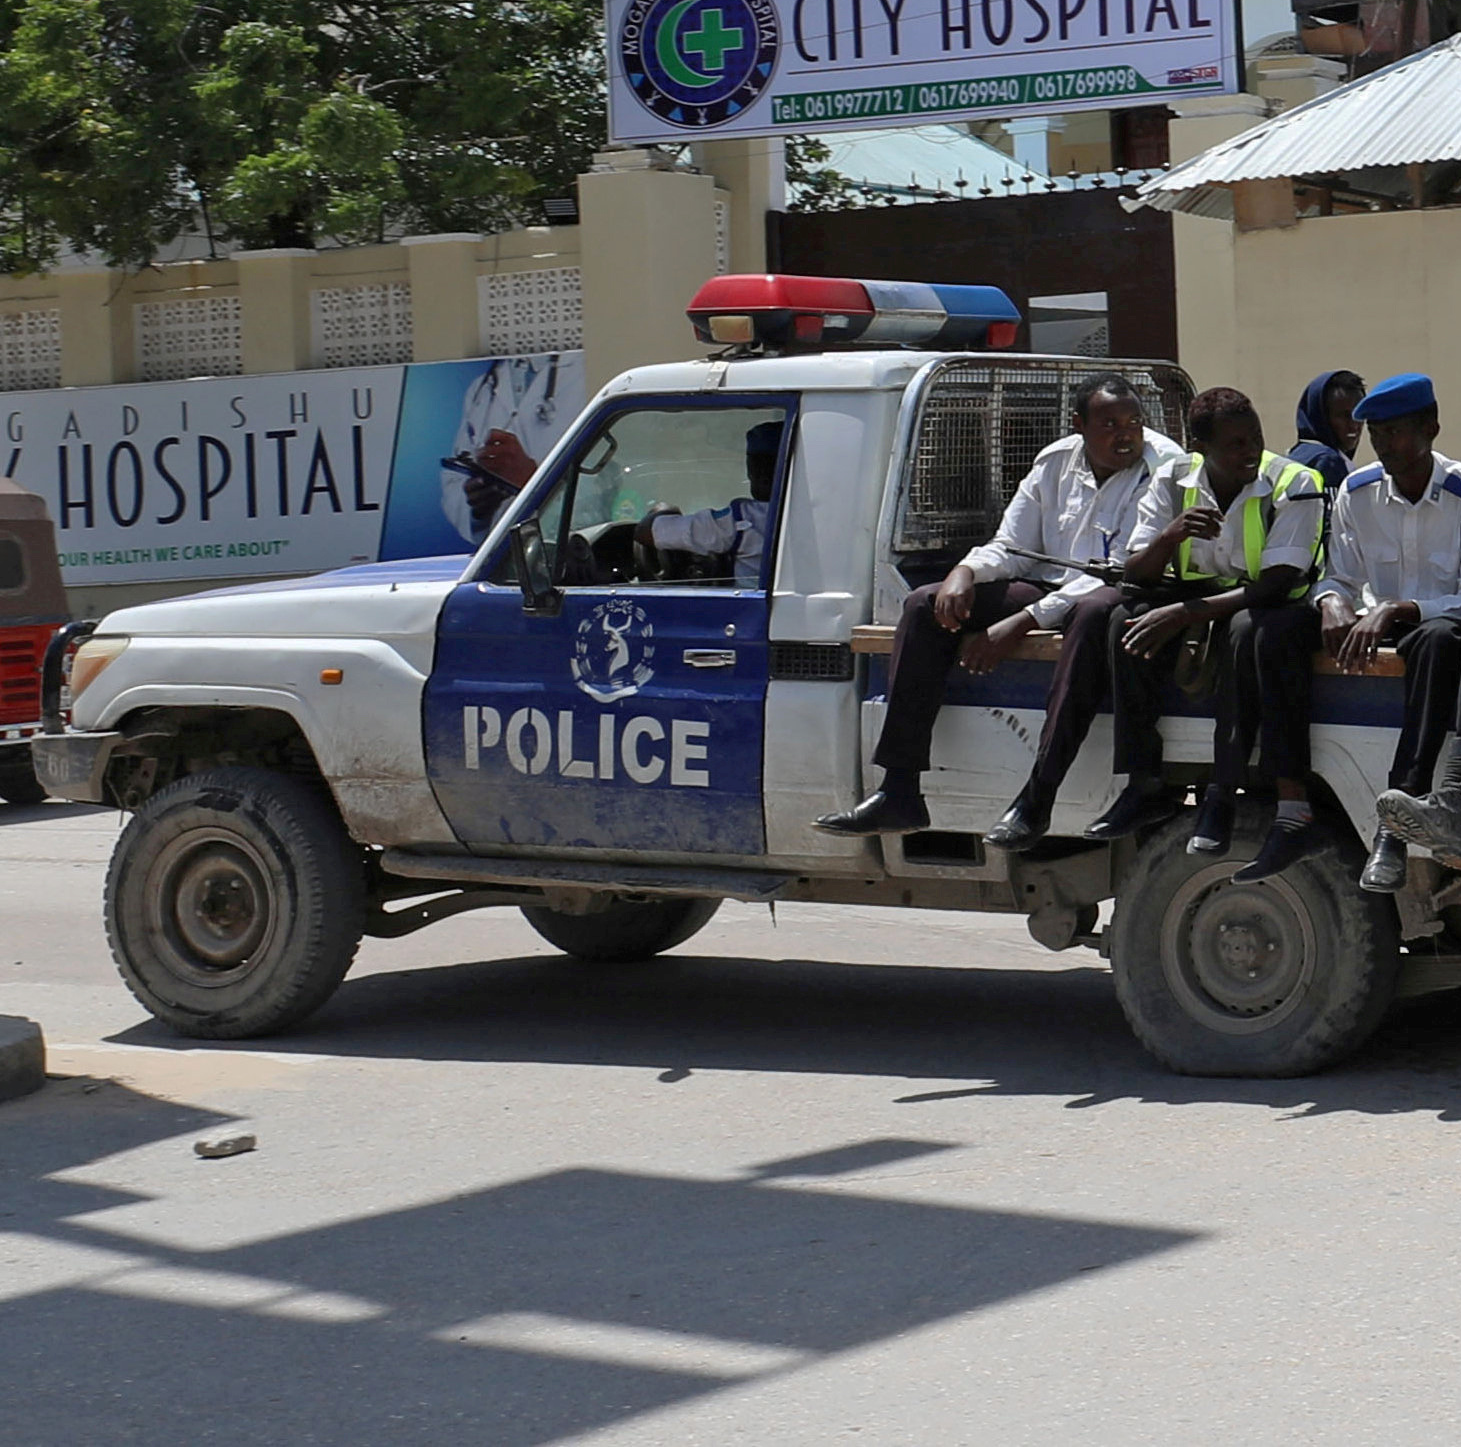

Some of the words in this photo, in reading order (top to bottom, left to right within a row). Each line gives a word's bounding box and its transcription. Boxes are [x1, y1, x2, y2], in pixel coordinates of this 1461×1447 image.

[773, 96, 801, 121] Tel:
[804, 89, 905, 119] 0619977712
[919, 78, 1019, 109] 0617699940
[1035, 68, 1137, 100] 0617699998
[58, 425, 380, 530] HOSPITAL
[93, 549, 153, 567] HEALTH
[154, 547, 180, 563] WE
[182, 544, 226, 561] CARE
[464, 706, 710, 787] POLICE
